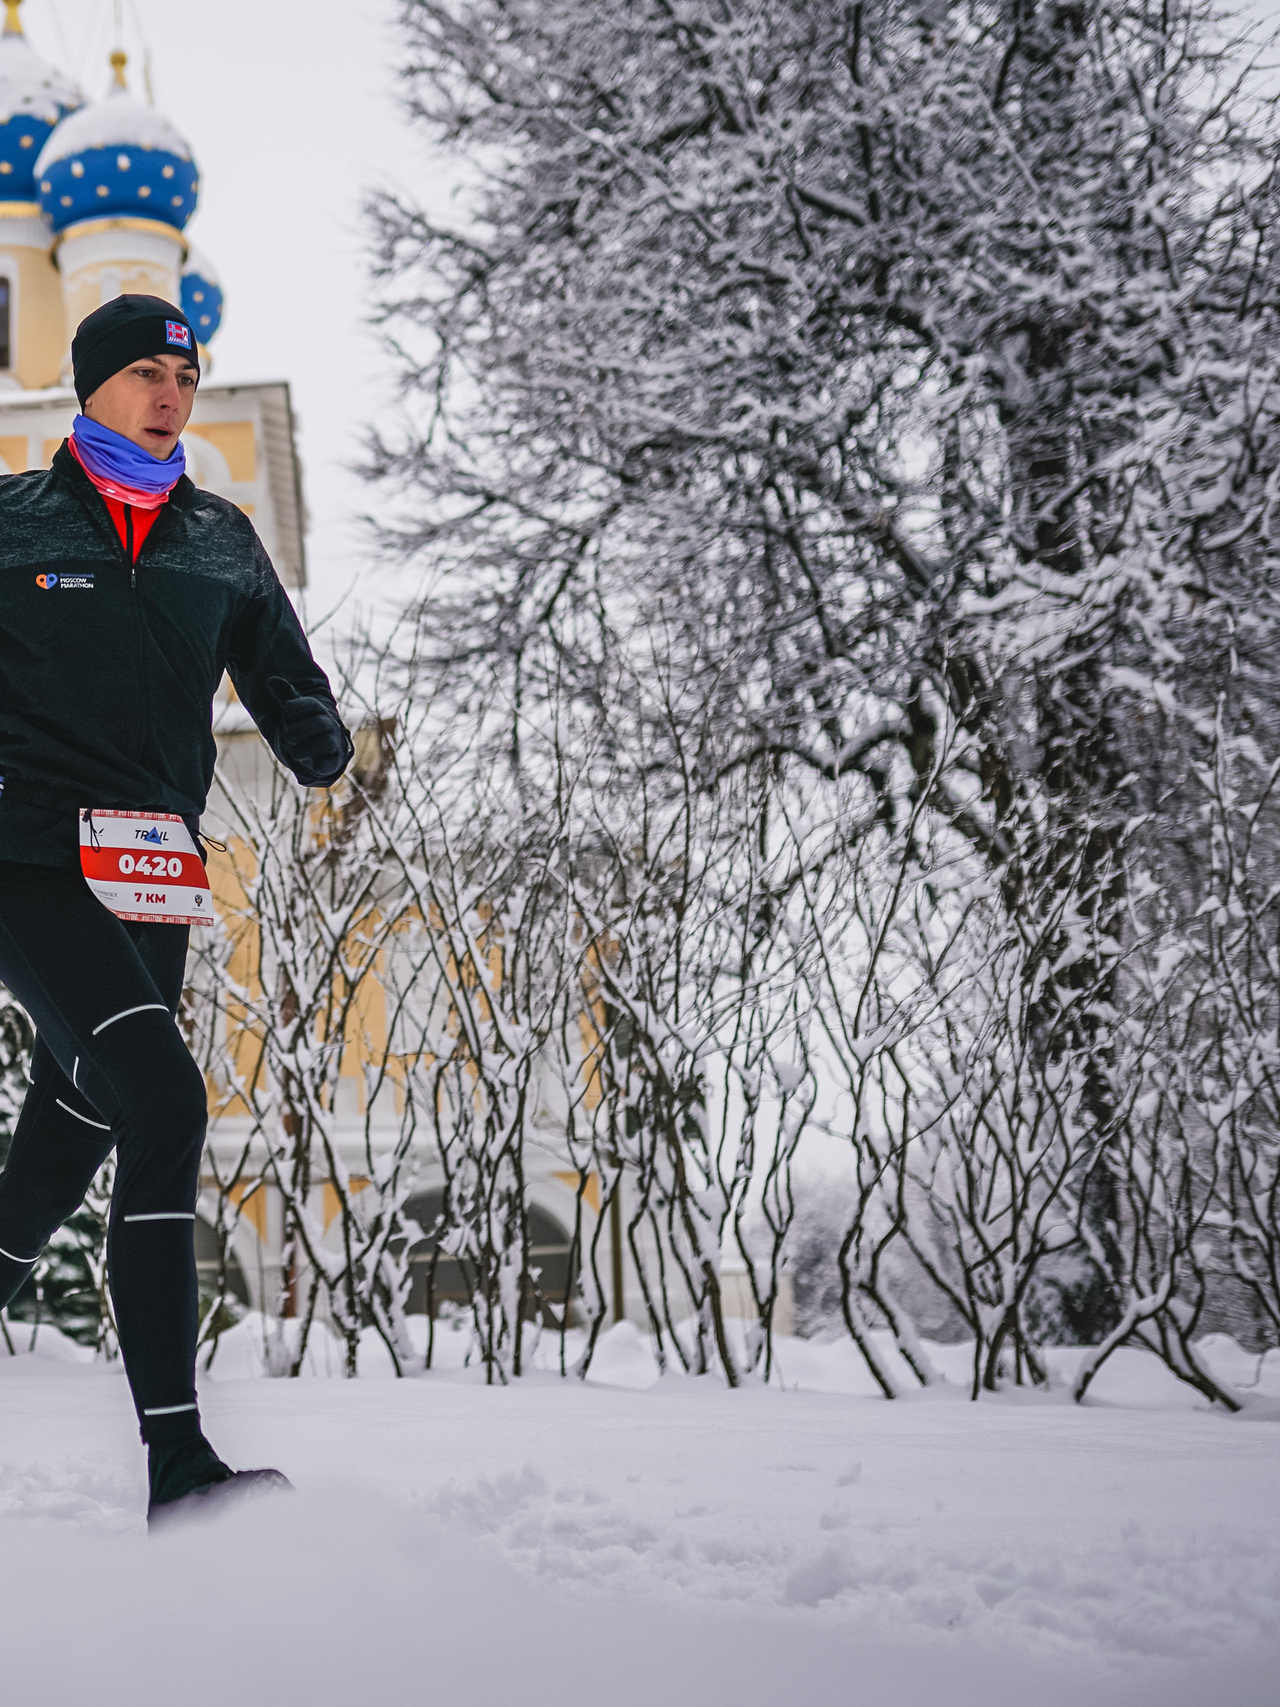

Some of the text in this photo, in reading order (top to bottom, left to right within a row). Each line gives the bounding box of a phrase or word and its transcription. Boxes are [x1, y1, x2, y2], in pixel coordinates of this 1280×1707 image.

[119, 854, 183, 877] 0420
[134, 892, 166, 904] 7 KM
